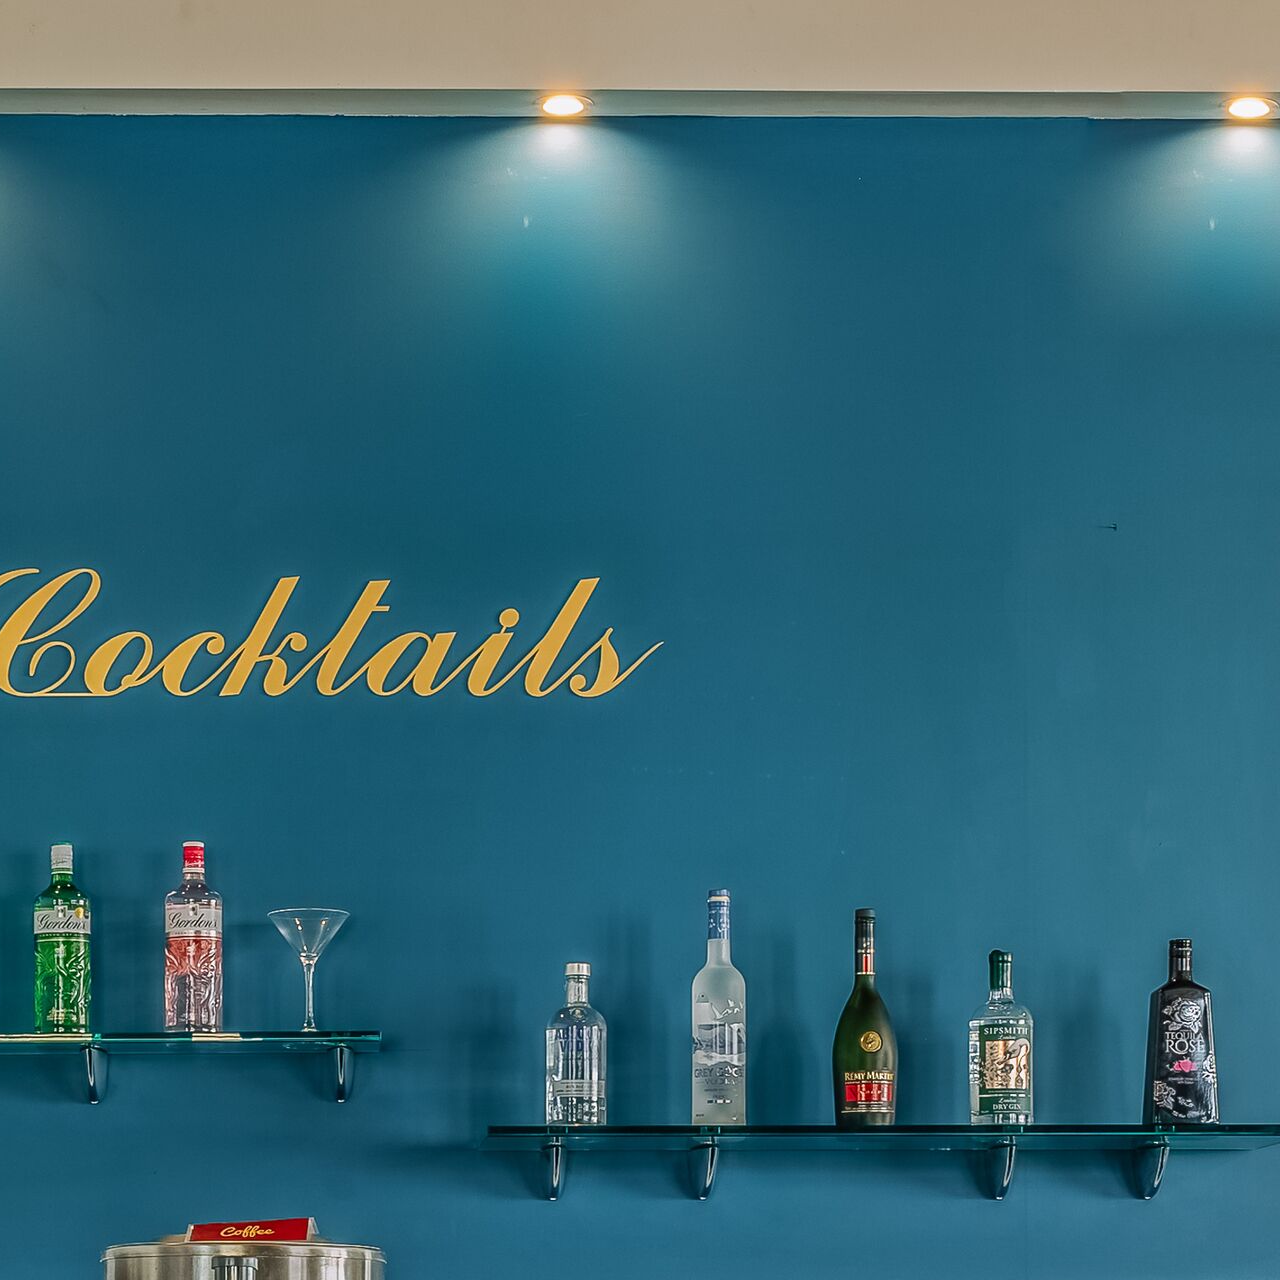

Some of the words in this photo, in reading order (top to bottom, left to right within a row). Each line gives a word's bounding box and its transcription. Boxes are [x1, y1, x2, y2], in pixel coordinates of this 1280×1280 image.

[983, 1026, 1029, 1036] SIPSMITH
[1165, 1031, 1204, 1042] TEQUILA
[1165, 1039, 1206, 1055] ROSE
[220, 1225, 275, 1239] Coffee
